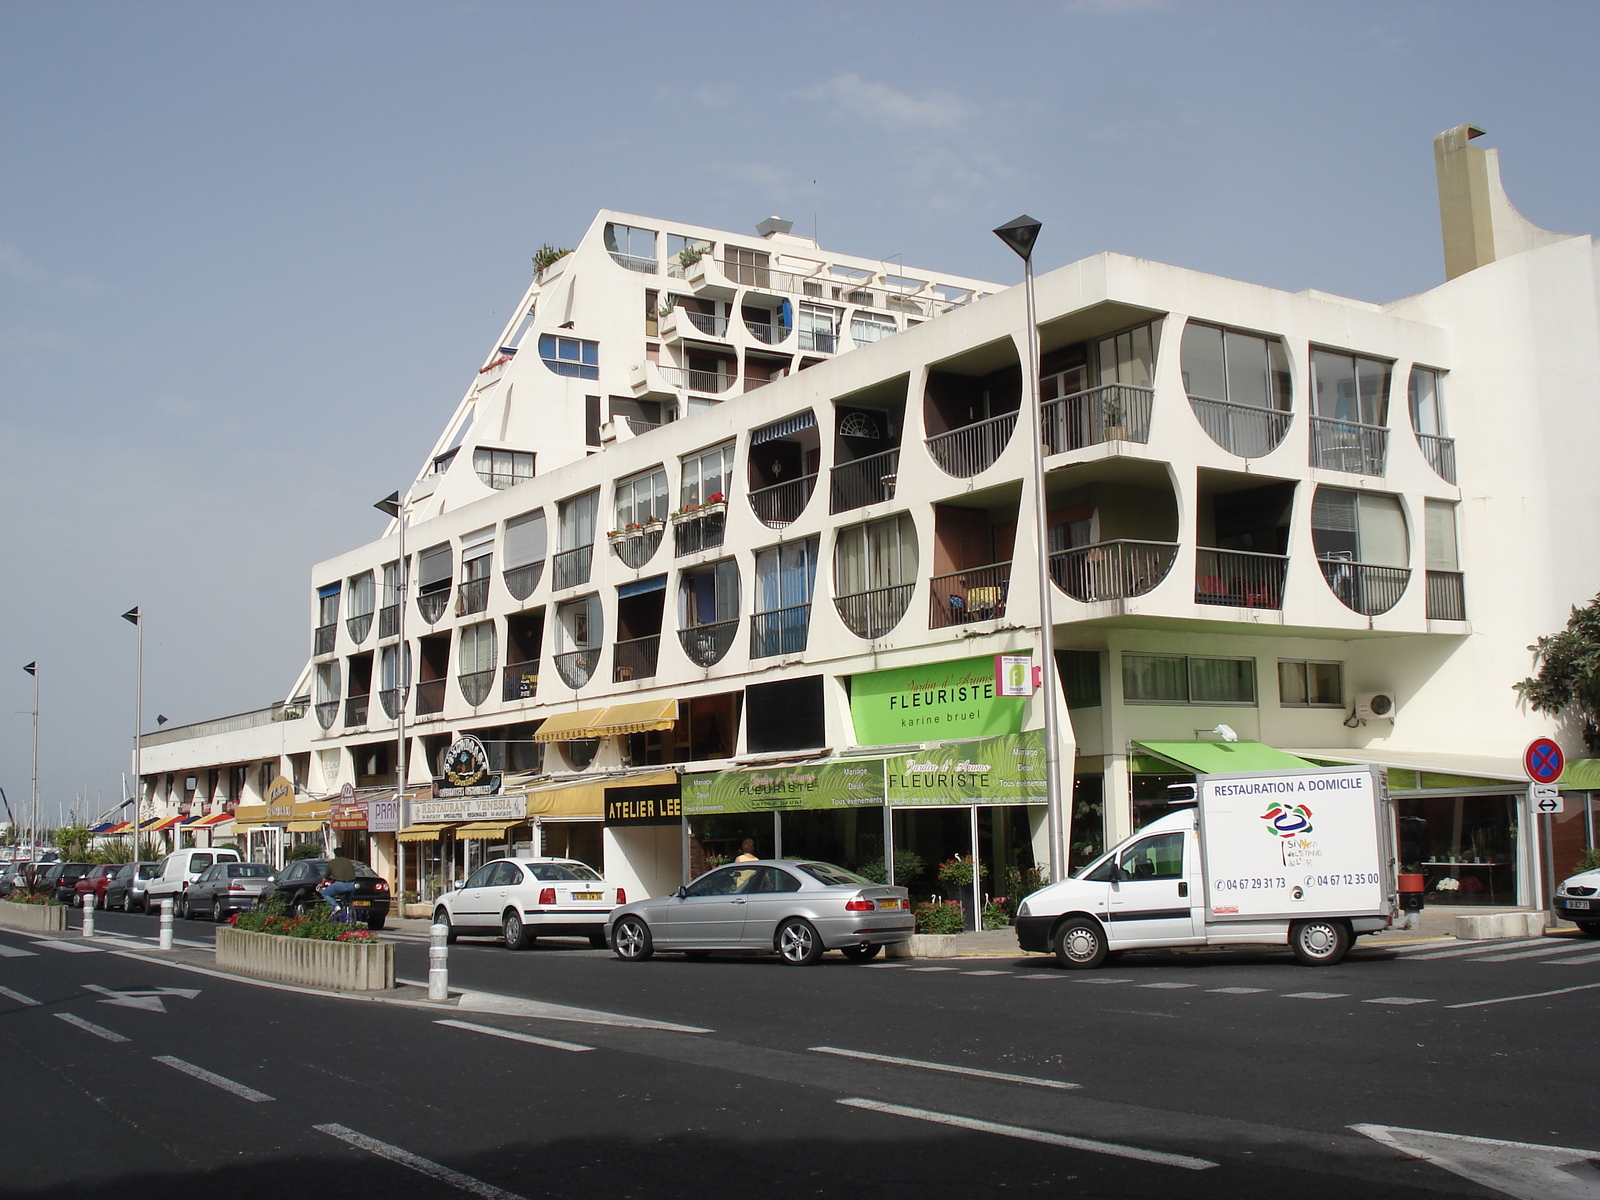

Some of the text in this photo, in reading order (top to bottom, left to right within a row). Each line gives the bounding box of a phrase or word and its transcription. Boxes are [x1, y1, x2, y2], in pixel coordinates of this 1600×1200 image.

[906, 679, 938, 698] Jardin
[956, 671, 994, 688] Arums
[890, 683, 993, 710] FLEURISTE
[901, 709, 980, 728] karine bruel
[606, 722, 646, 734] VENESIA
[1012, 747, 1038, 757] Mariage
[843, 767, 868, 777] Mariage
[905, 758, 939, 776] Jardin
[954, 759, 992, 773] Arums
[1017, 763, 1034, 772] Deuil
[848, 782, 864, 790] Deuil
[889, 773, 990, 788] FLEURISTE
[999, 779, 1015, 787] Tous
[1214, 777, 1362, 797] RESTAURATION A DOMICILE
[696, 791, 710, 799] Deuil
[739, 782, 814, 796] FLEURISTE
[421, 798, 512, 814] RESTAURANT VENESIA
[608, 798, 681, 819] ATELIER LEE
[831, 798, 846, 806] Tous
[1226, 877, 1286, 891] 04 67 29 31 73
[1317, 872, 1379, 887] 04 67 12 35 00
